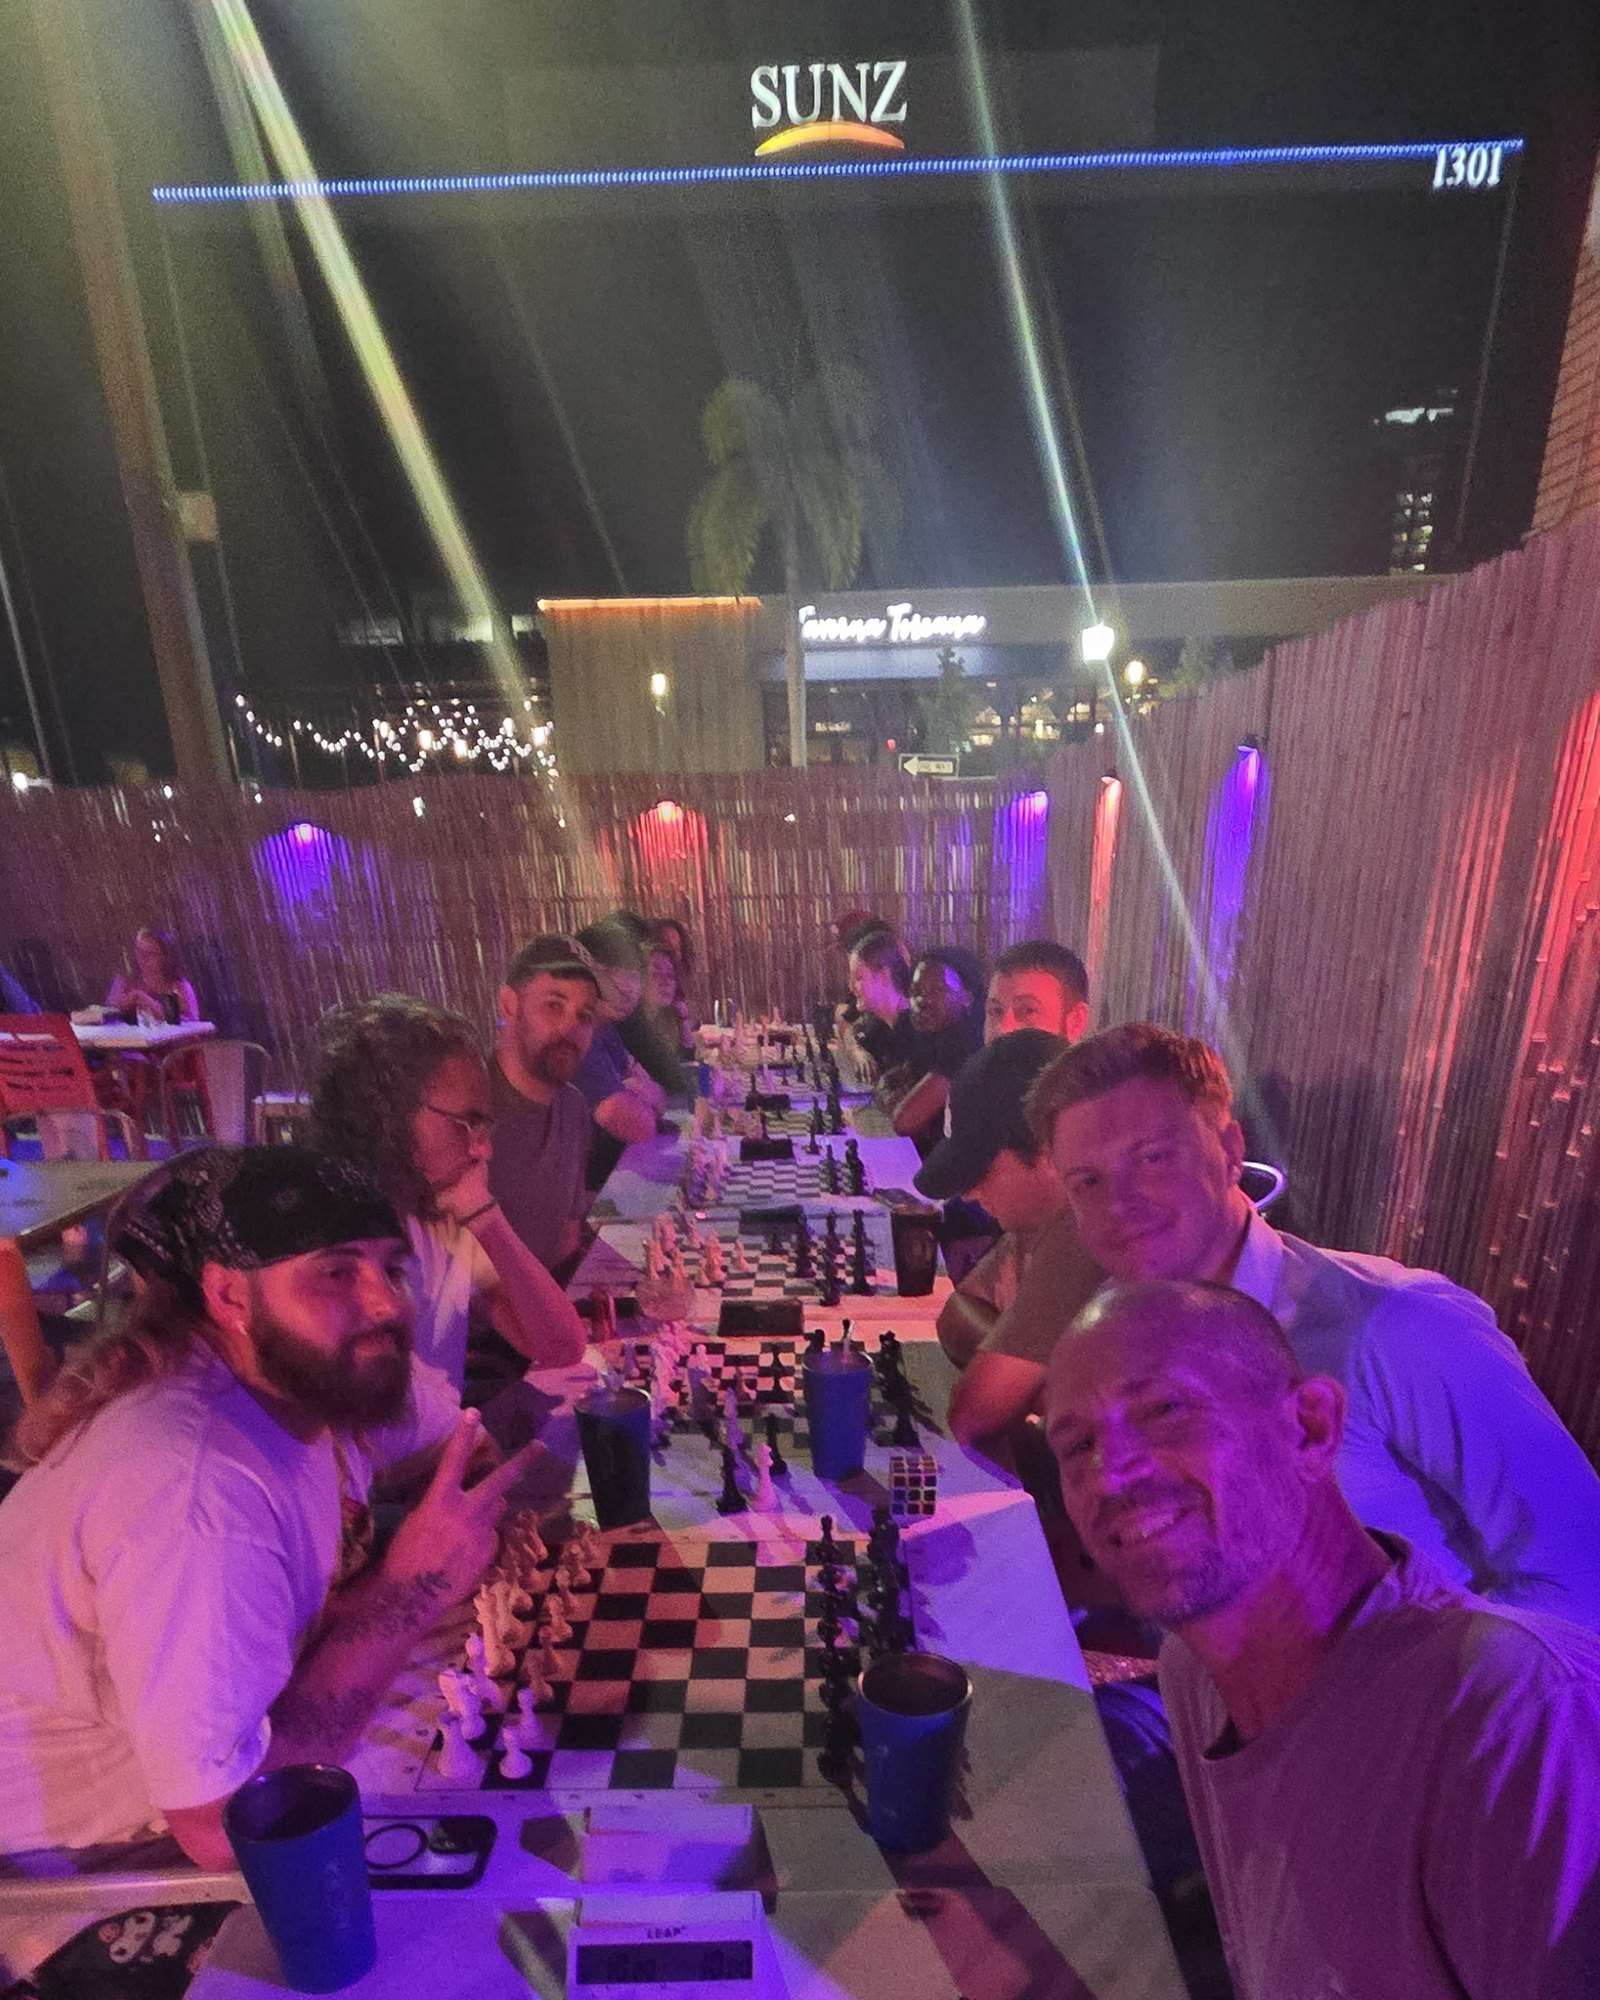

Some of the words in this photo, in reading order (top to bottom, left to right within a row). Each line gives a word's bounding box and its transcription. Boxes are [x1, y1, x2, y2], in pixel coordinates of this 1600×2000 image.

[750, 61, 908, 128] SUNZ
[1432, 146, 1503, 189] 1301
[647, 1926, 681, 1939] LEAP
